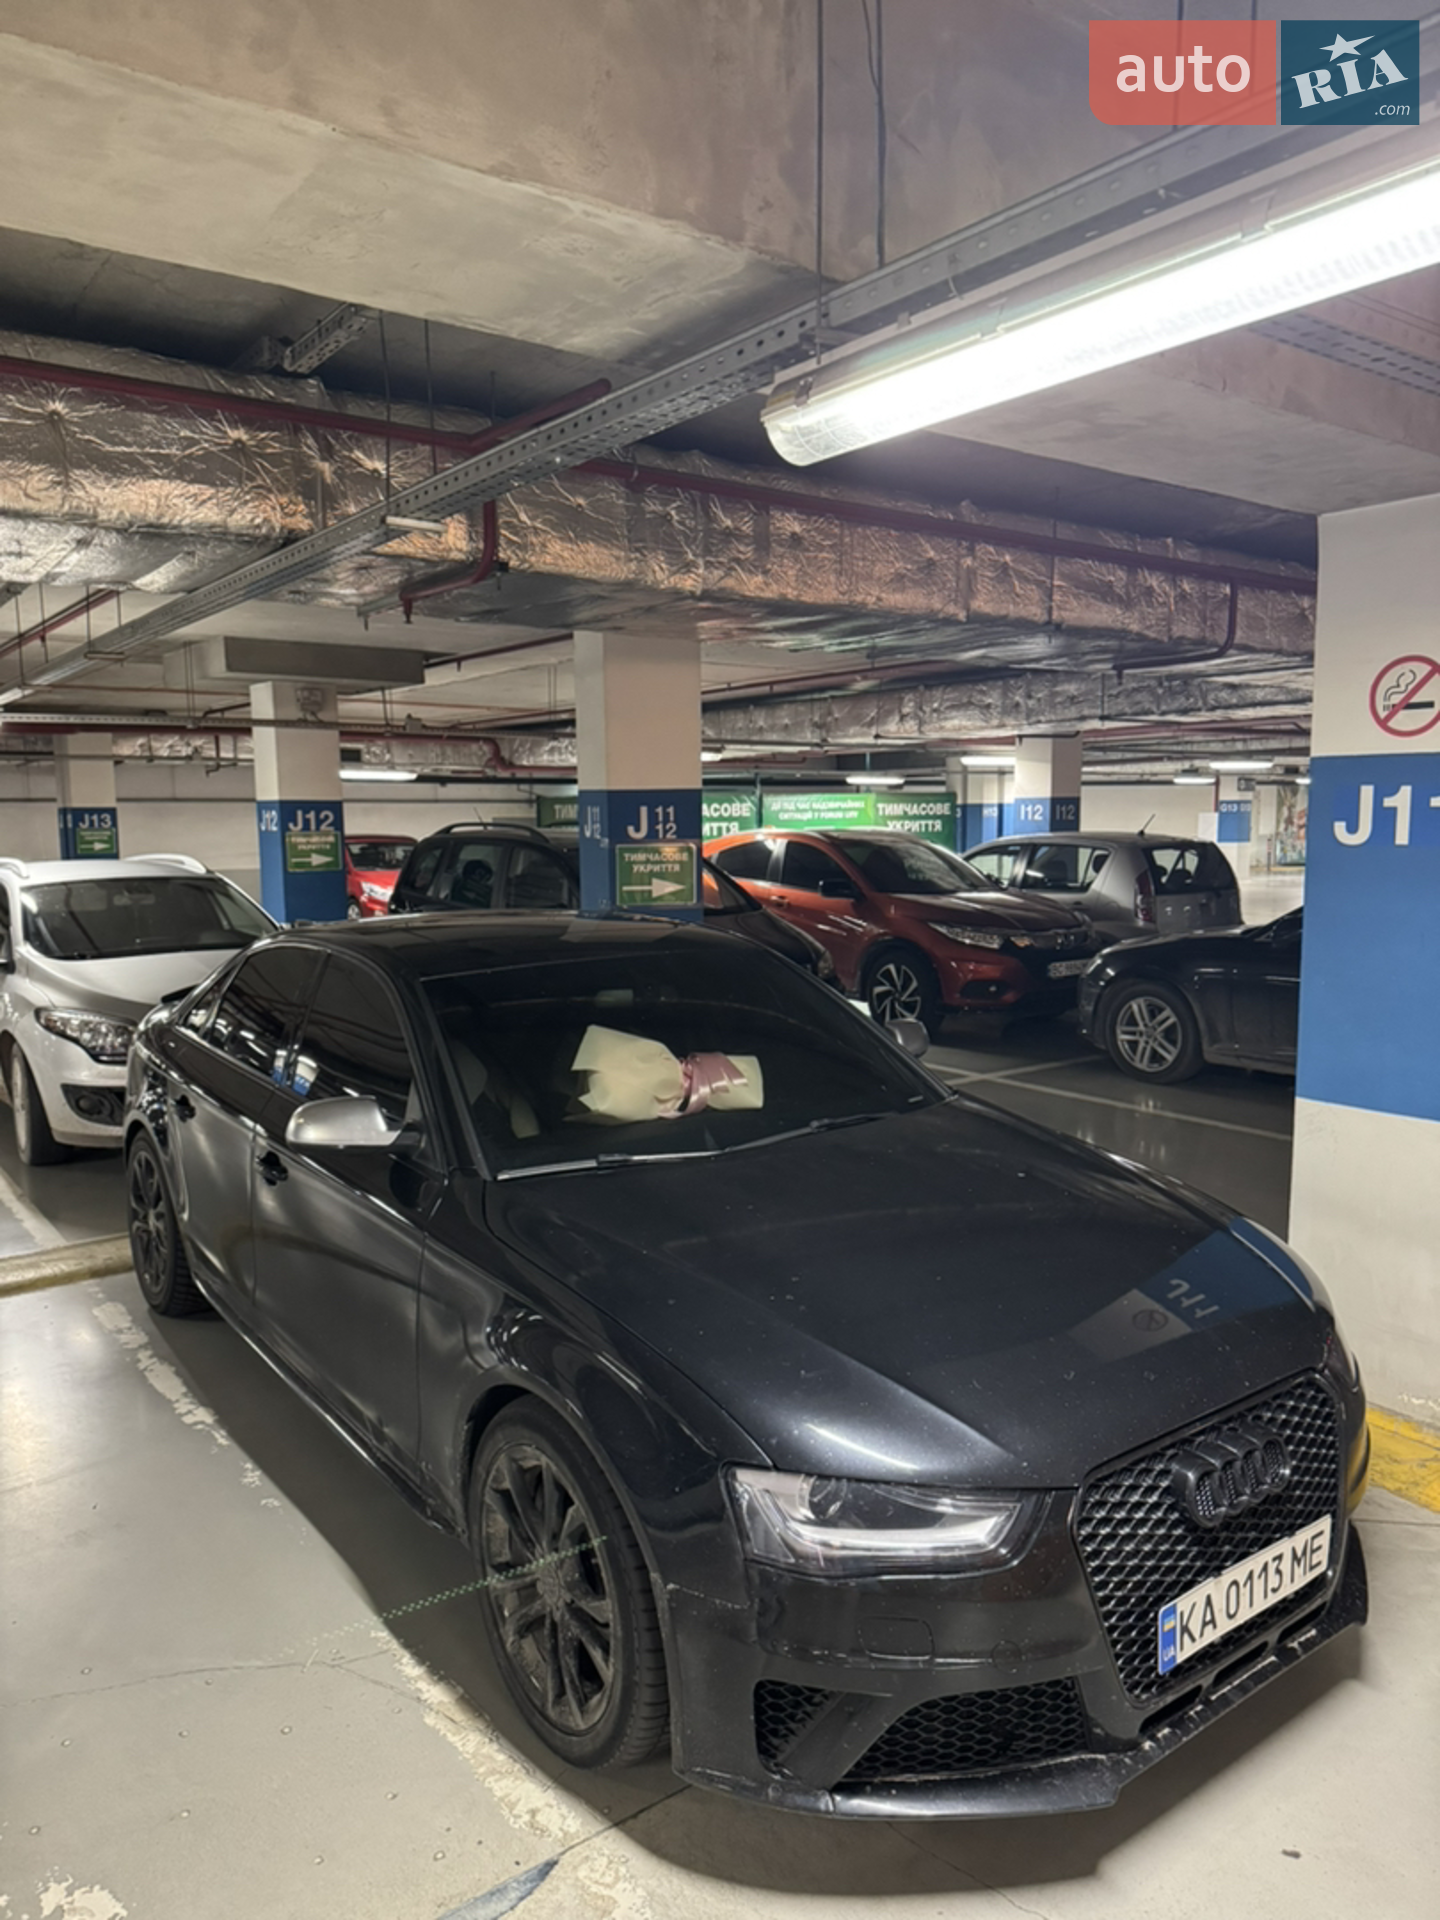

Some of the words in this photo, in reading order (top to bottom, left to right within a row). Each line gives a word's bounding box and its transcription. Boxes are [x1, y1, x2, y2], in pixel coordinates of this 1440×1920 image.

[876, 802, 951, 816] ТИМЧАСОВЕ
[79, 812, 112, 829] J13
[260, 810, 279, 832] J12
[288, 809, 336, 832] J12
[627, 805, 649, 840] J
[655, 805, 675, 822] 11
[887, 819, 943, 833] УКРИТТЯ
[655, 822, 677, 839] 12
[624, 852, 689, 862] ТИМЧАСОВЕ
[633, 864, 680, 873] УКРИТТЯ
[1179, 1593, 1218, 1652] KA
[1225, 1552, 1284, 1620] 0113
[1290, 1529, 1325, 1584] ME
